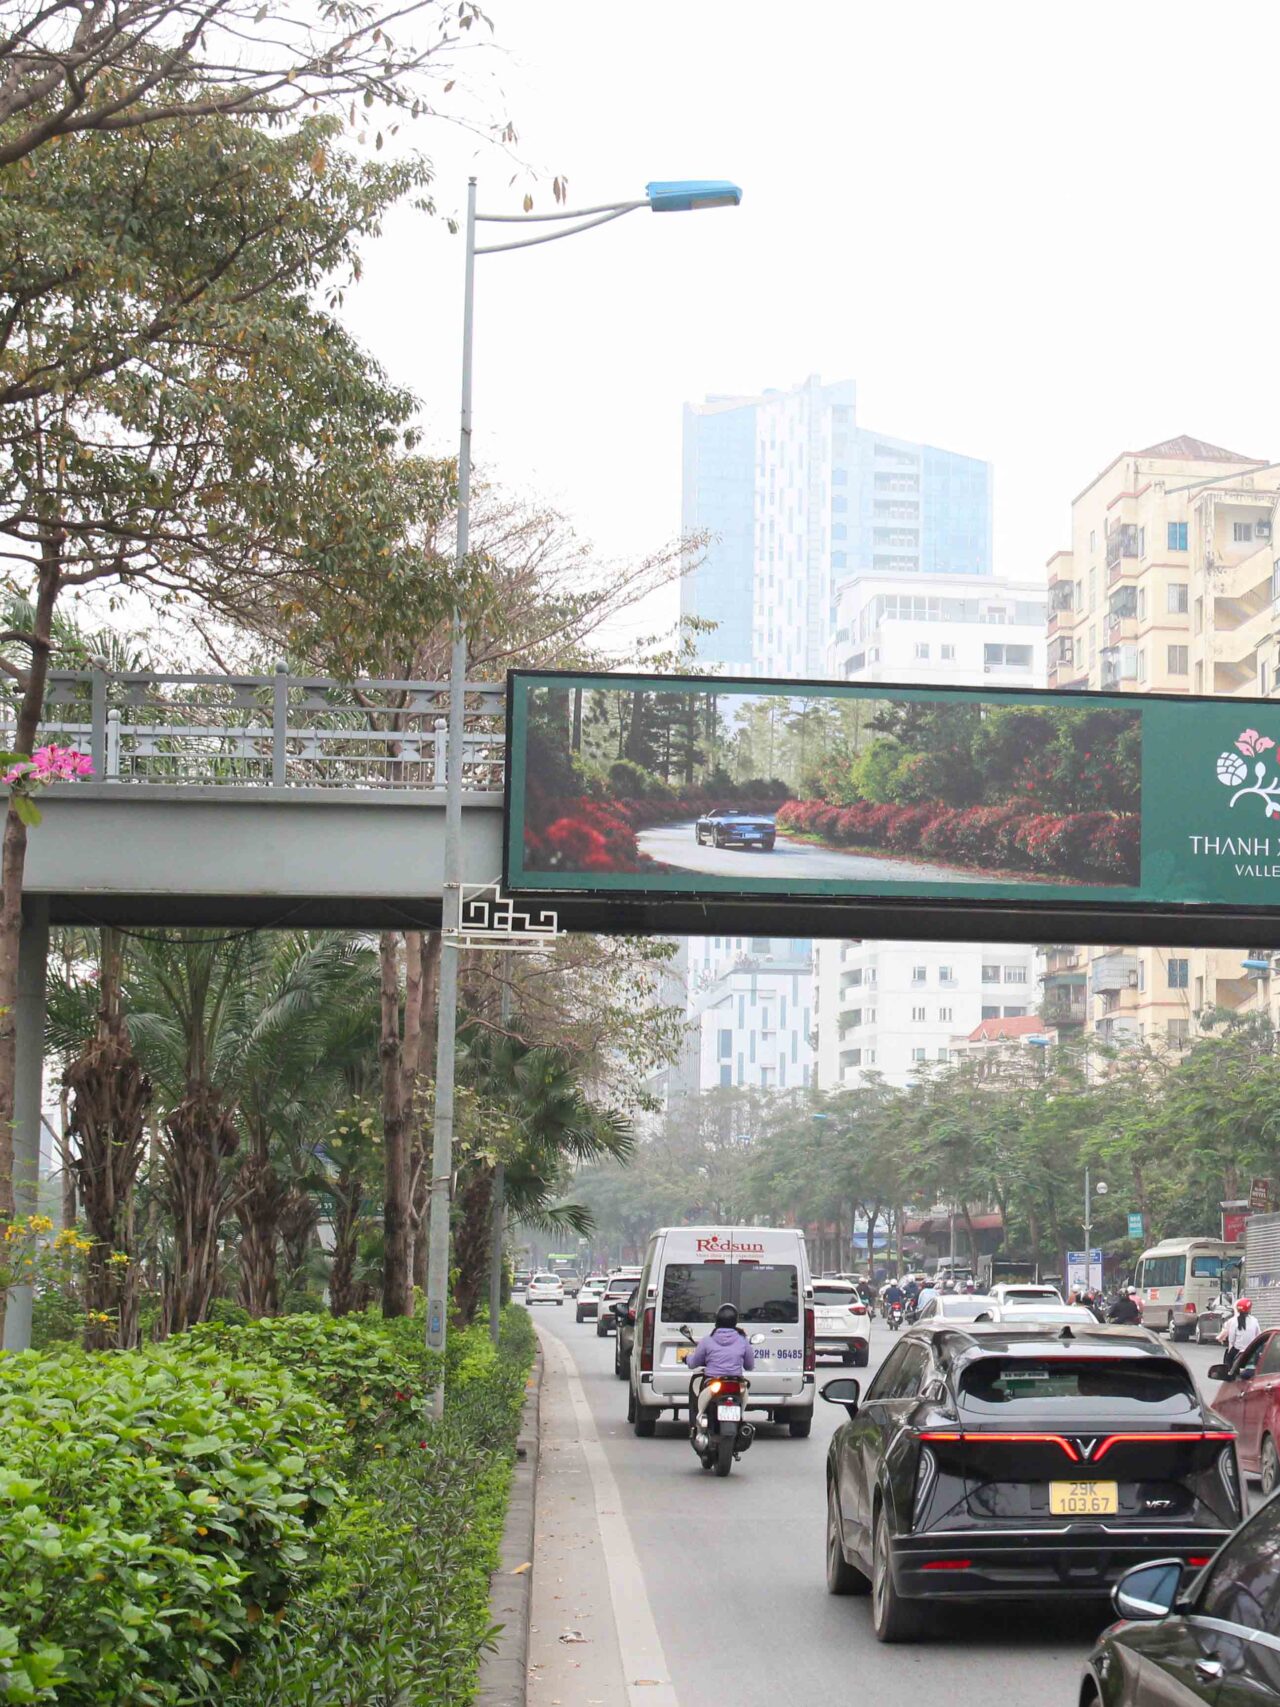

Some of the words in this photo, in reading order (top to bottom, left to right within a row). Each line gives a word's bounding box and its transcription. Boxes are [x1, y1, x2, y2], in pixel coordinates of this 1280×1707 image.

[1188, 836, 1269, 857] THANH
[696, 1239, 765, 1253] Redsun
[754, 1349, 770, 1359] 29H
[777, 1349, 803, 1359] 96485
[1070, 1482, 1097, 1496] 29K
[1060, 1497, 1110, 1512] 103.67
